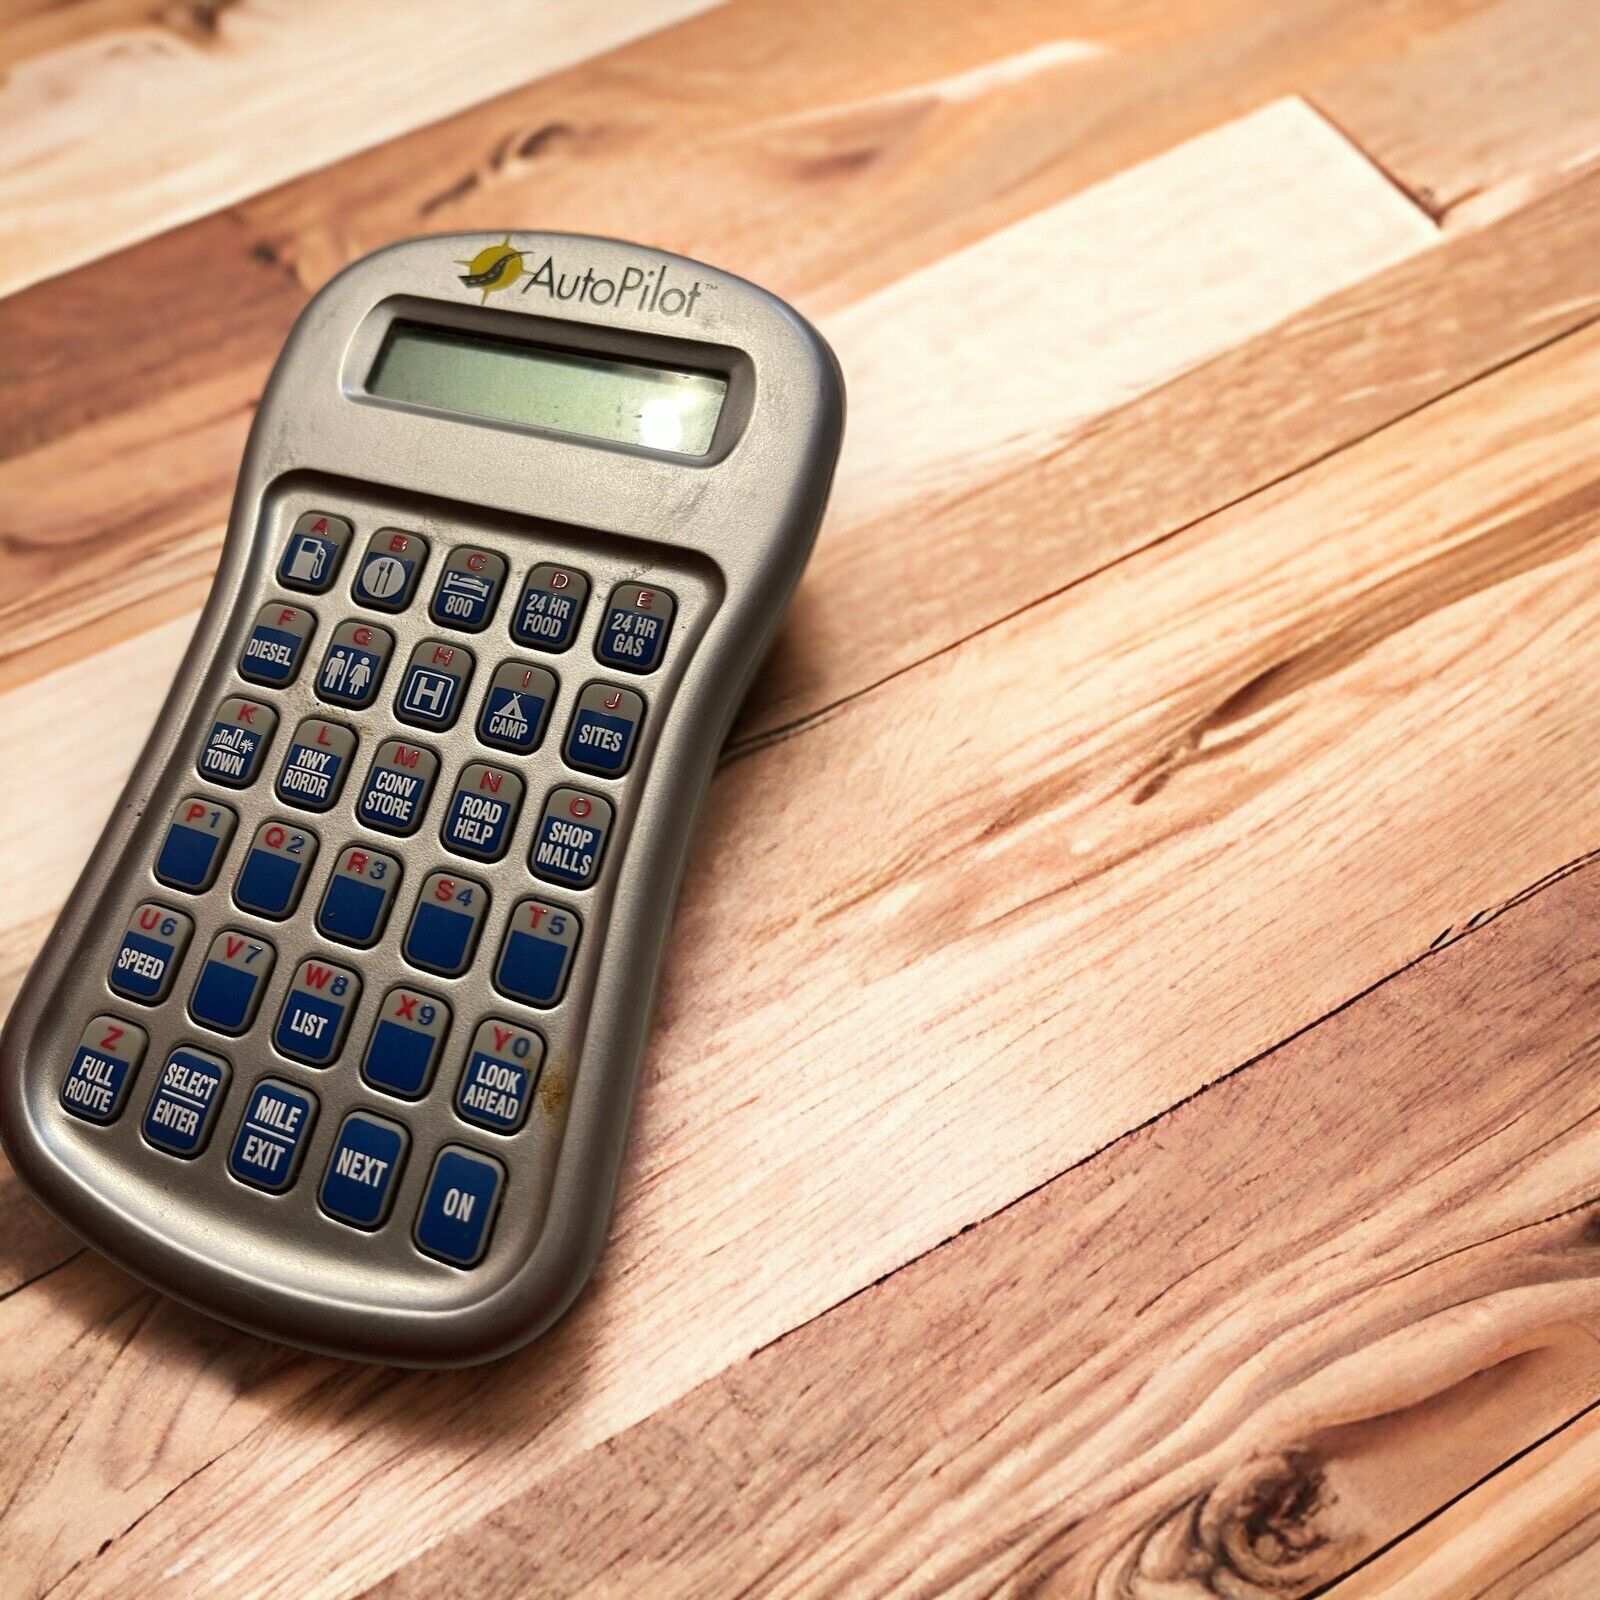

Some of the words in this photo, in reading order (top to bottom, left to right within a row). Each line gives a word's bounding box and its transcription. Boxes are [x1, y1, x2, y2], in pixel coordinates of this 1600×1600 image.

[522, 257, 701, 317] AutoPilot
[312, 518, 328, 534] A
[389, 534, 407, 551] B
[468, 554, 486, 571] C
[552, 571, 569, 589] D
[445, 596, 473, 618] 800
[526, 594, 545, 613] 24
[550, 600, 570, 619] HR
[636, 591, 654, 609] E
[278, 609, 297, 625] F
[523, 614, 562, 637] FOOD
[611, 613, 630, 631] 24
[634, 617, 657, 639] HR
[353, 628, 373, 646] G
[613, 633, 645, 657] GAS
[247, 639, 292, 667] DIESEL
[432, 647, 454, 667] H
[522, 670, 531, 687] I
[412, 677, 445, 710] H
[605, 692, 620, 709] J
[237, 704, 257, 724] K
[316, 725, 331, 746] L
[489, 716, 528, 740] CAMP
[579, 724, 622, 752] SITES
[205, 749, 245, 776] TOWN
[297, 749, 331, 772] HWY
[394, 746, 420, 768] M
[283, 769, 329, 798] BORDR
[375, 771, 417, 798] CONV
[480, 771, 503, 793] N
[365, 791, 412, 821] STORE
[460, 796, 502, 824] ROAD
[569, 797, 592, 818] O
[453, 818, 494, 845] HELP
[549, 822, 593, 849] SHOP
[537, 842, 592, 876] MALLS
[118, 947, 164, 980] SPEED
[99, 1024, 125, 1051] Z
[290, 1009, 328, 1039] LIST
[78, 1055, 114, 1087] FULL
[164, 1063, 218, 1100] SELECT
[476, 1061, 522, 1095] LOOK
[66, 1077, 113, 1113] ROUTE
[463, 1084, 519, 1120] AHEAD
[153, 1099, 199, 1136] ENTER
[254, 1096, 302, 1133] MILE
[242, 1135, 285, 1171] EXIT
[336, 1148, 388, 1187] NEXT
[443, 1188, 475, 1222] ON
